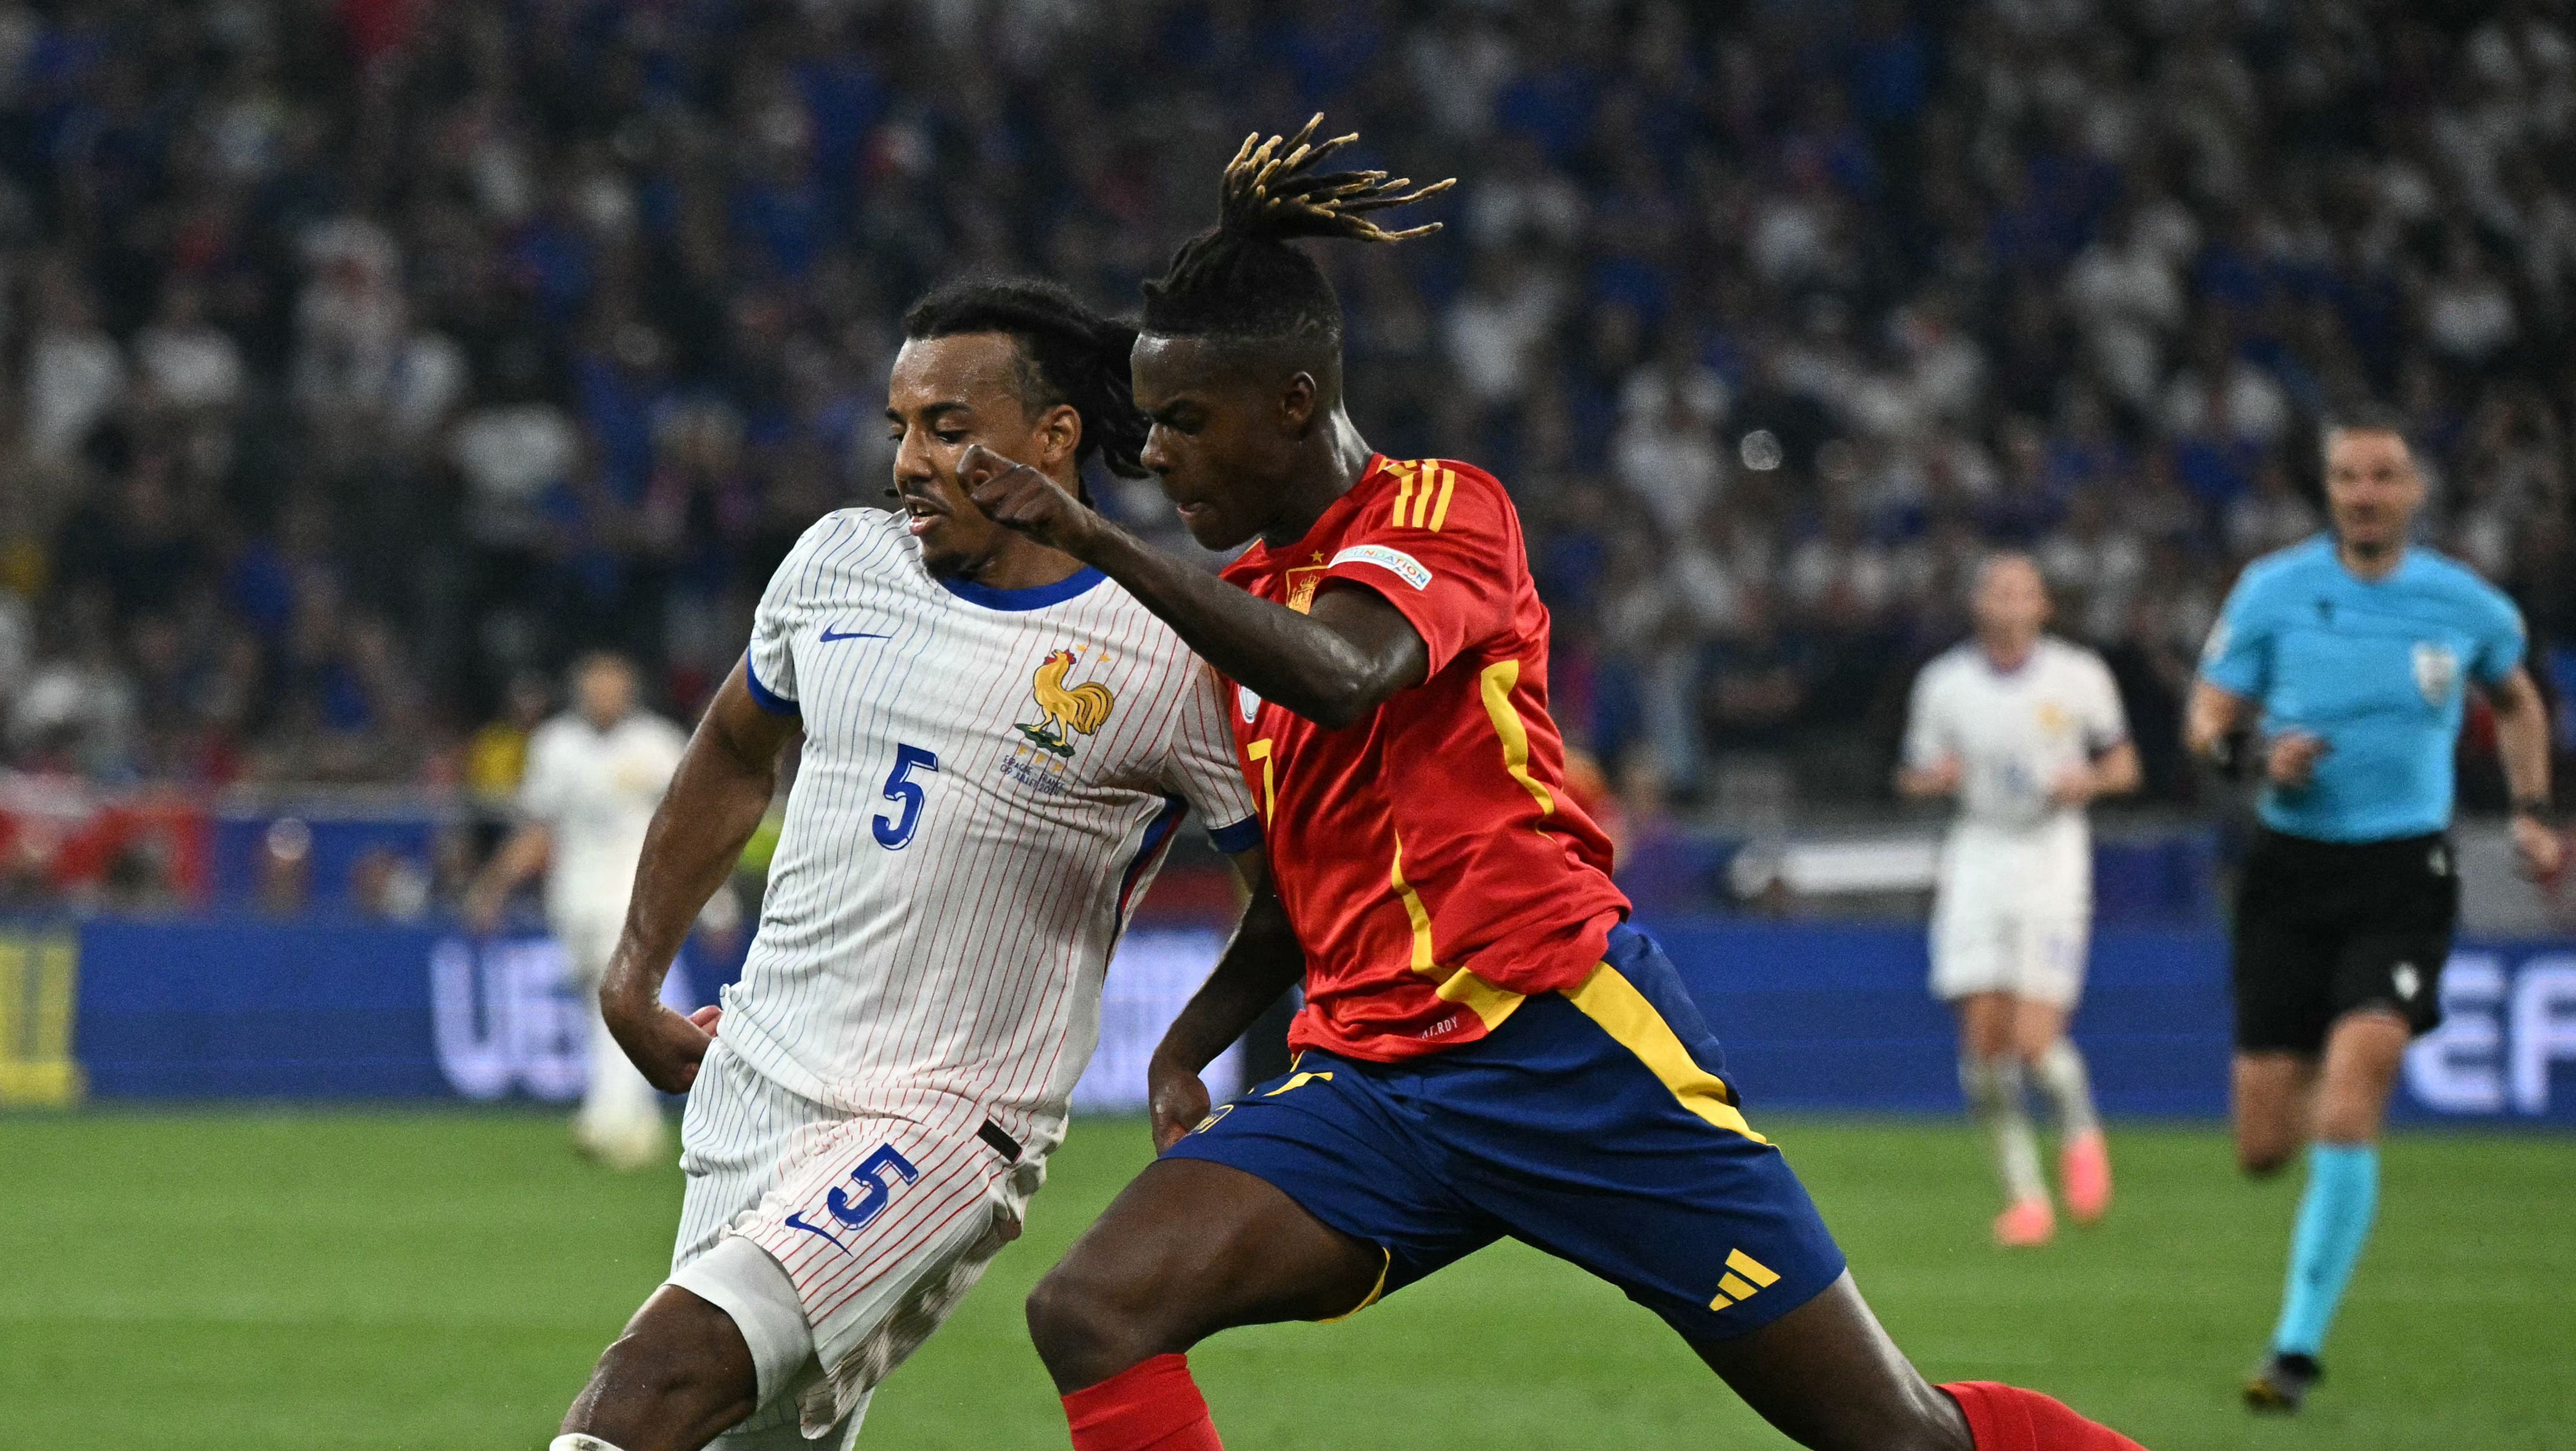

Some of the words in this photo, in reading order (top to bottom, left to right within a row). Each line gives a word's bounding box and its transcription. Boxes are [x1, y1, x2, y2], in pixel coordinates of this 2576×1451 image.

[872, 743, 939, 851] 5
[1247, 738, 1275, 832] 7
[827, 1142, 919, 1231] 5
